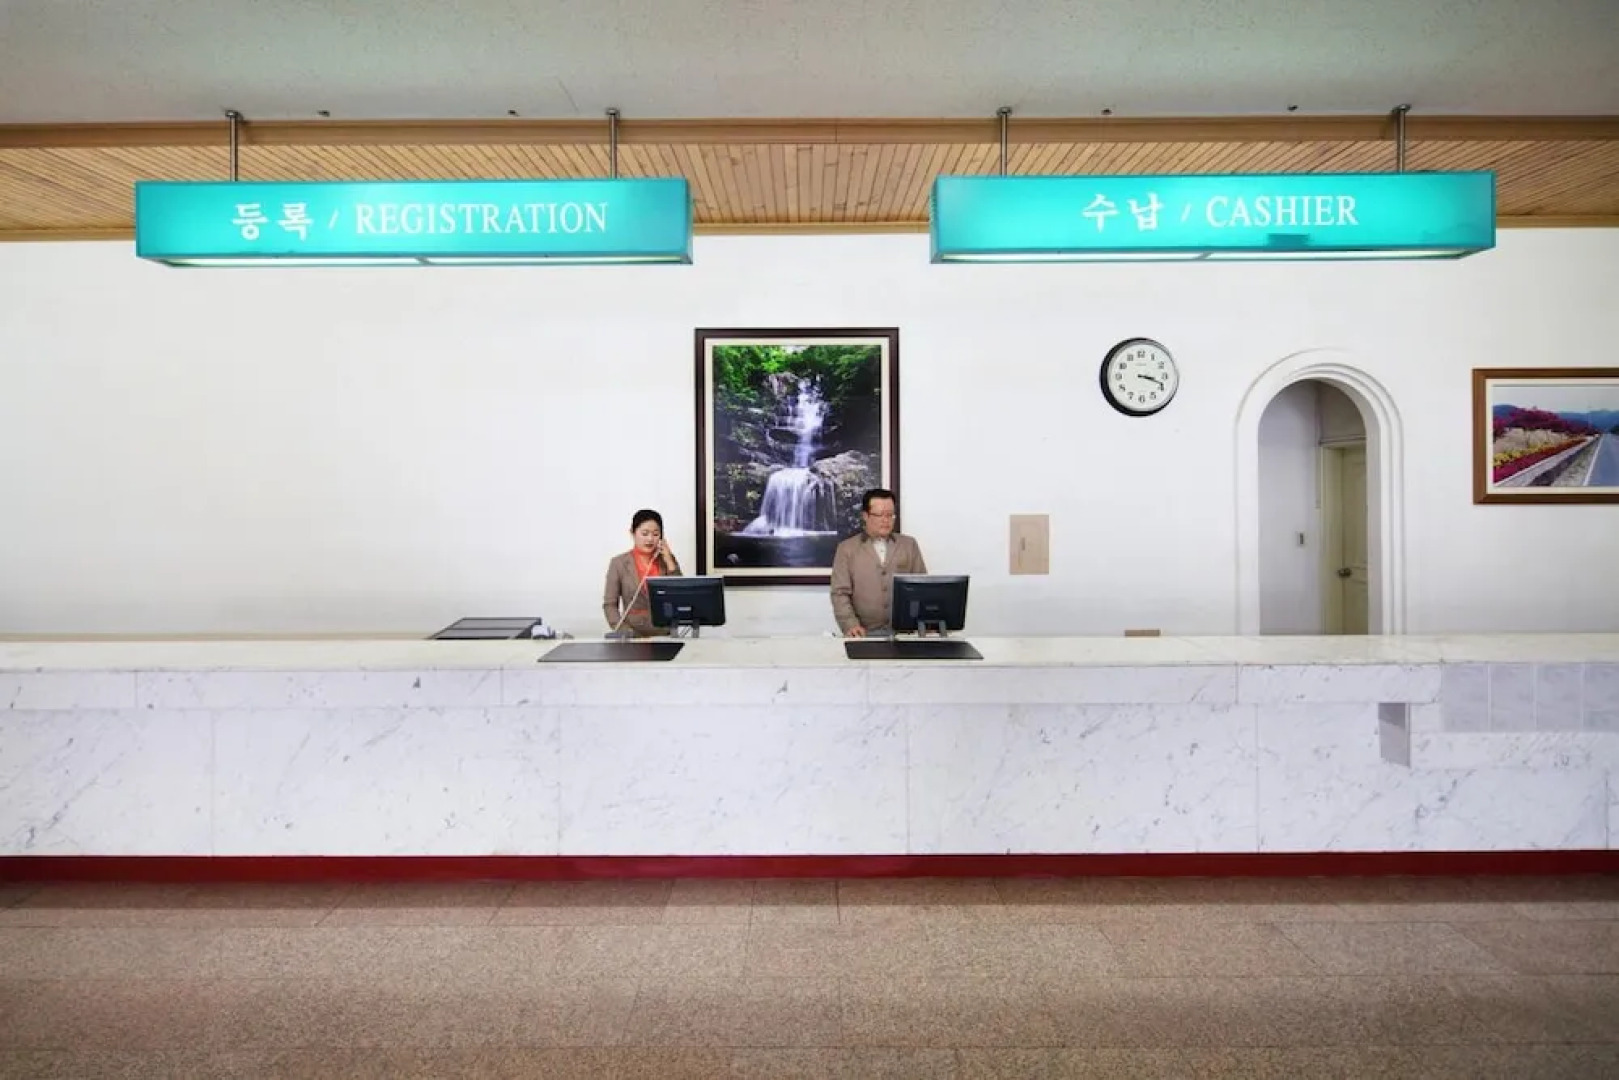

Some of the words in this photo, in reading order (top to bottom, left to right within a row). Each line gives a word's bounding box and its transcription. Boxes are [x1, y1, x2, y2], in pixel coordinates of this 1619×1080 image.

[232, 202, 314, 241] 등록
[355, 201, 608, 235] REGISTRATION
[1081, 192, 1164, 232] 수납
[1206, 195, 1358, 228] CASHIER
